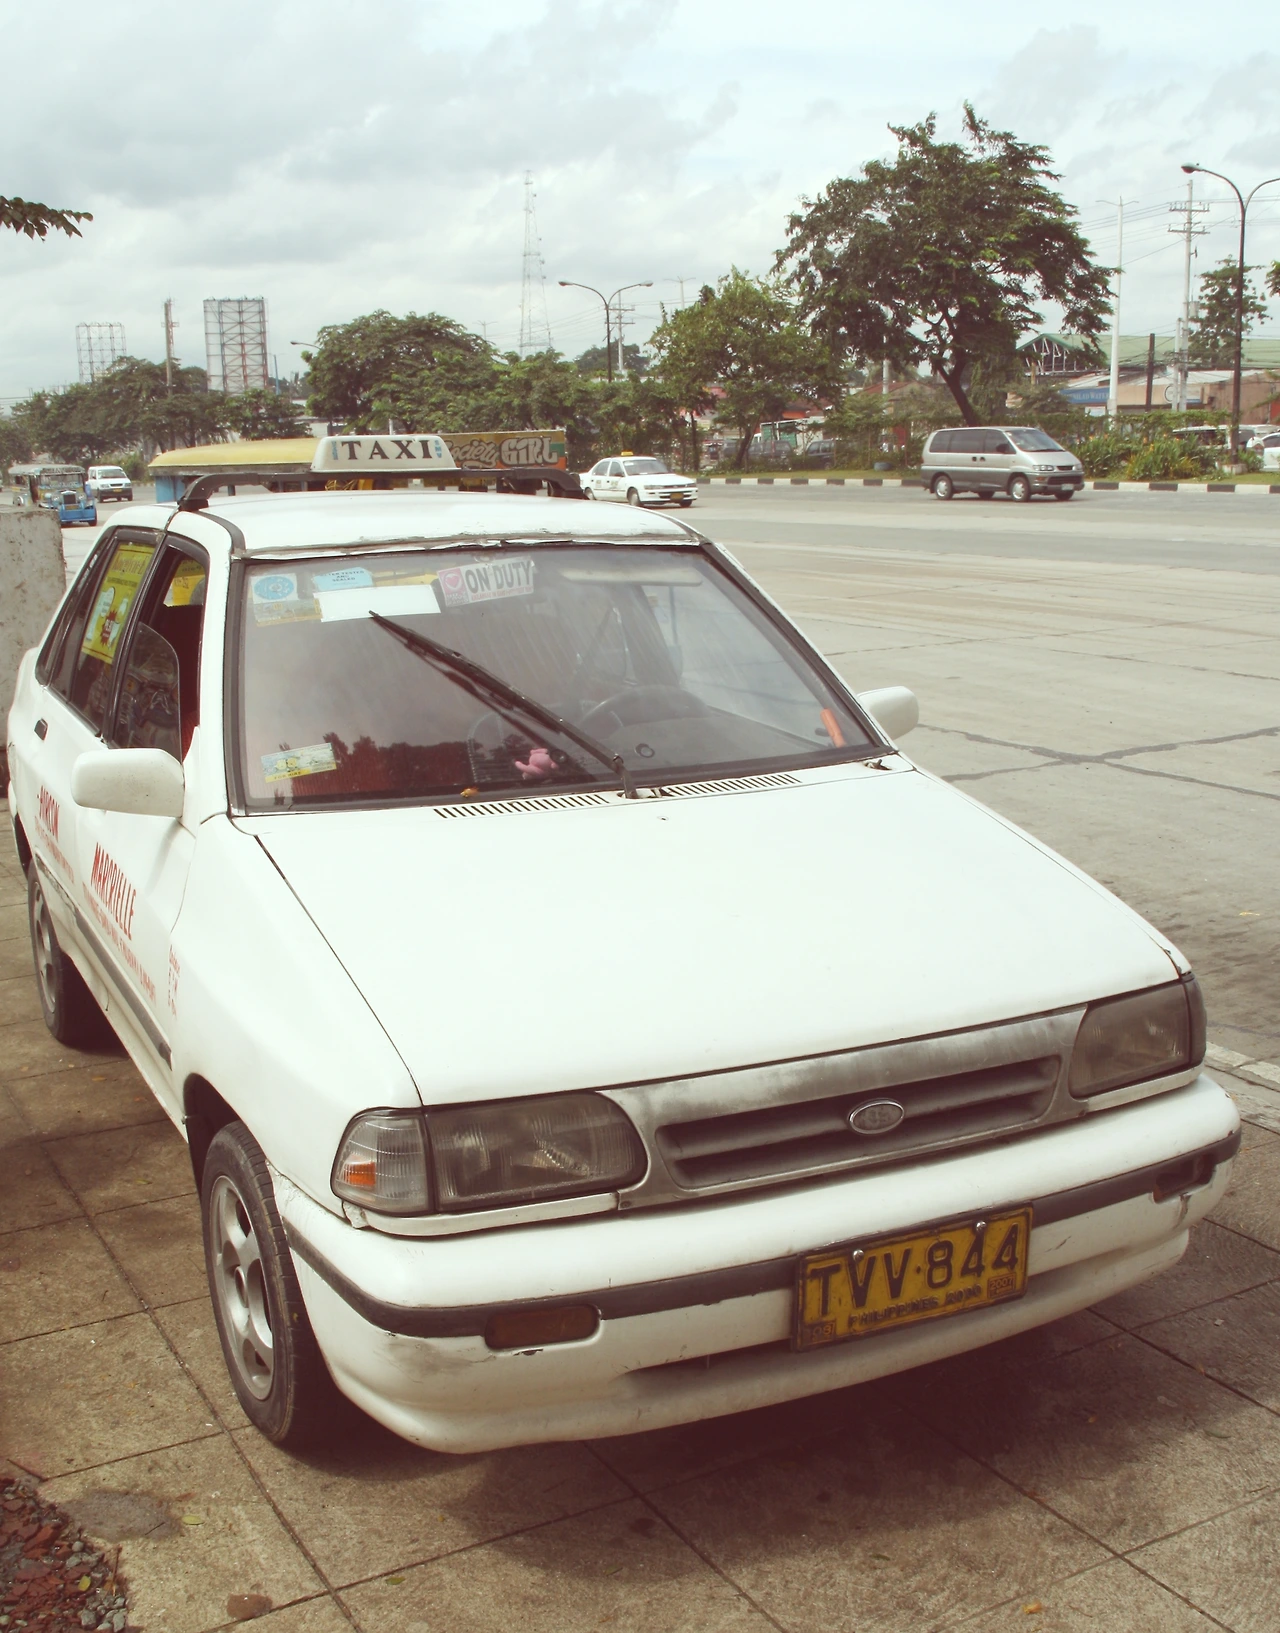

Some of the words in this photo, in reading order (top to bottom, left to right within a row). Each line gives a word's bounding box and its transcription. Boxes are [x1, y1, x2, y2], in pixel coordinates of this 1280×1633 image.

[341, 439, 433, 460] TAXI
[464, 567, 491, 594] ON
[493, 560, 531, 589] DUTY
[990, 1276, 1013, 1290] 2007
